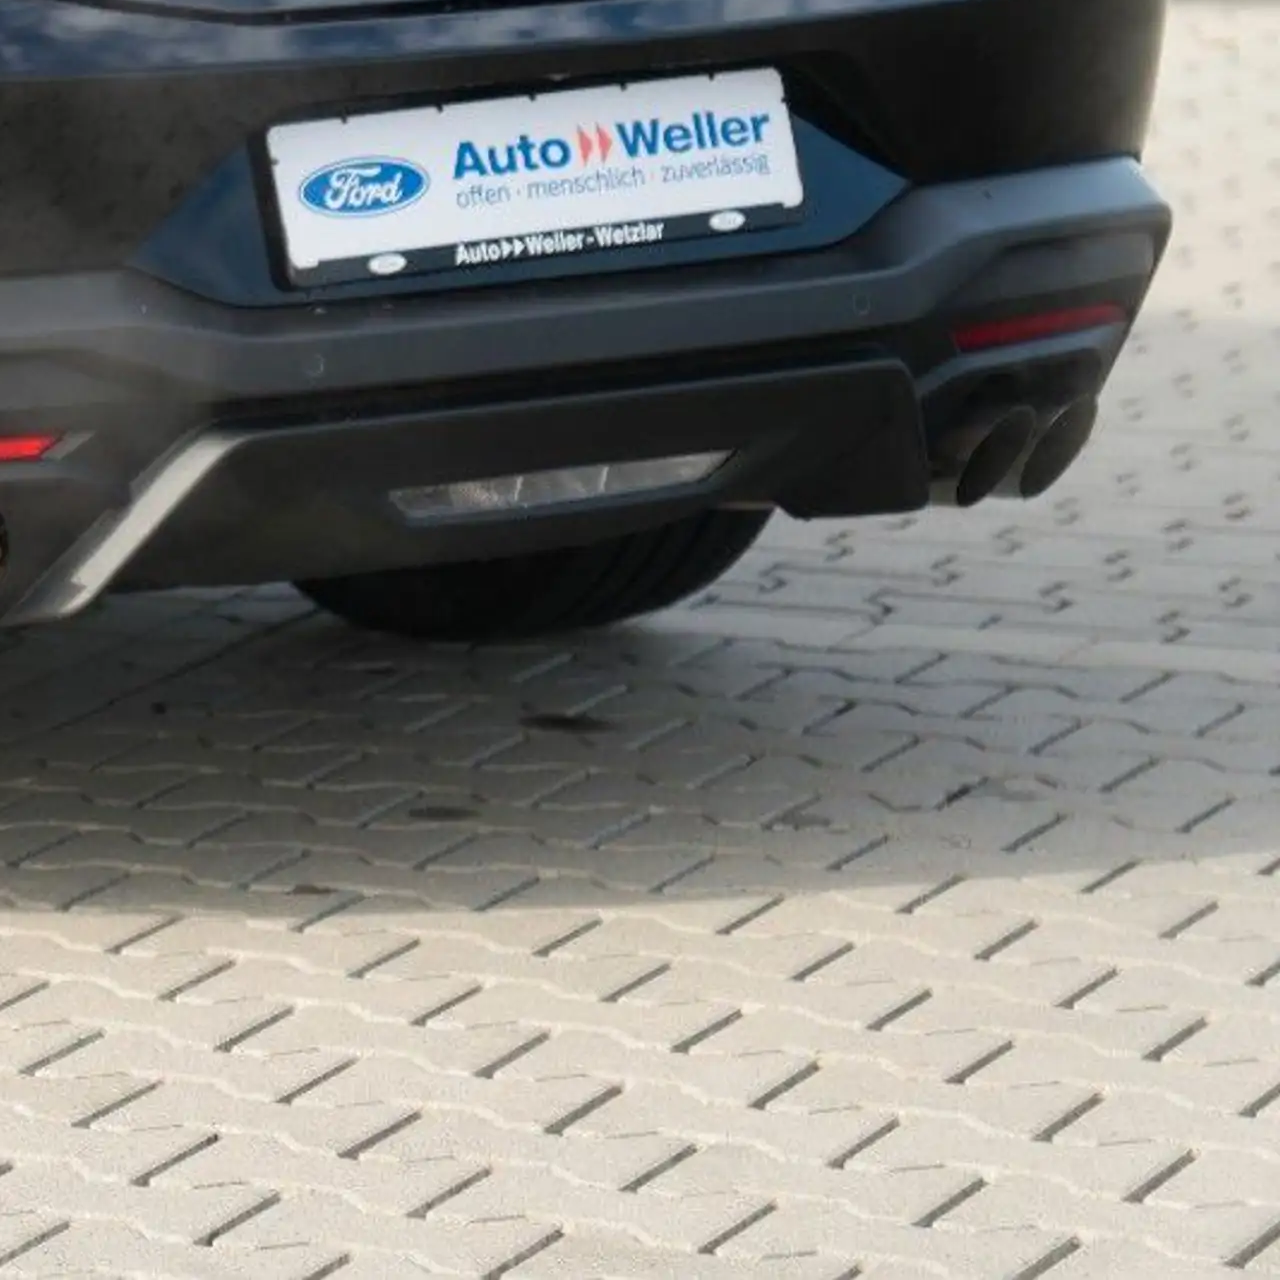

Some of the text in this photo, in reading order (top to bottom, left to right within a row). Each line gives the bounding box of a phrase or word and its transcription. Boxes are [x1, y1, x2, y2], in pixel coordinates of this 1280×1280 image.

[453, 110, 771, 180] Auto Weller
[324, 164, 403, 209] Ford
[456, 183, 511, 209] offen
[526, 166, 646, 199] menschlich
[455, 243, 502, 266] Auto
